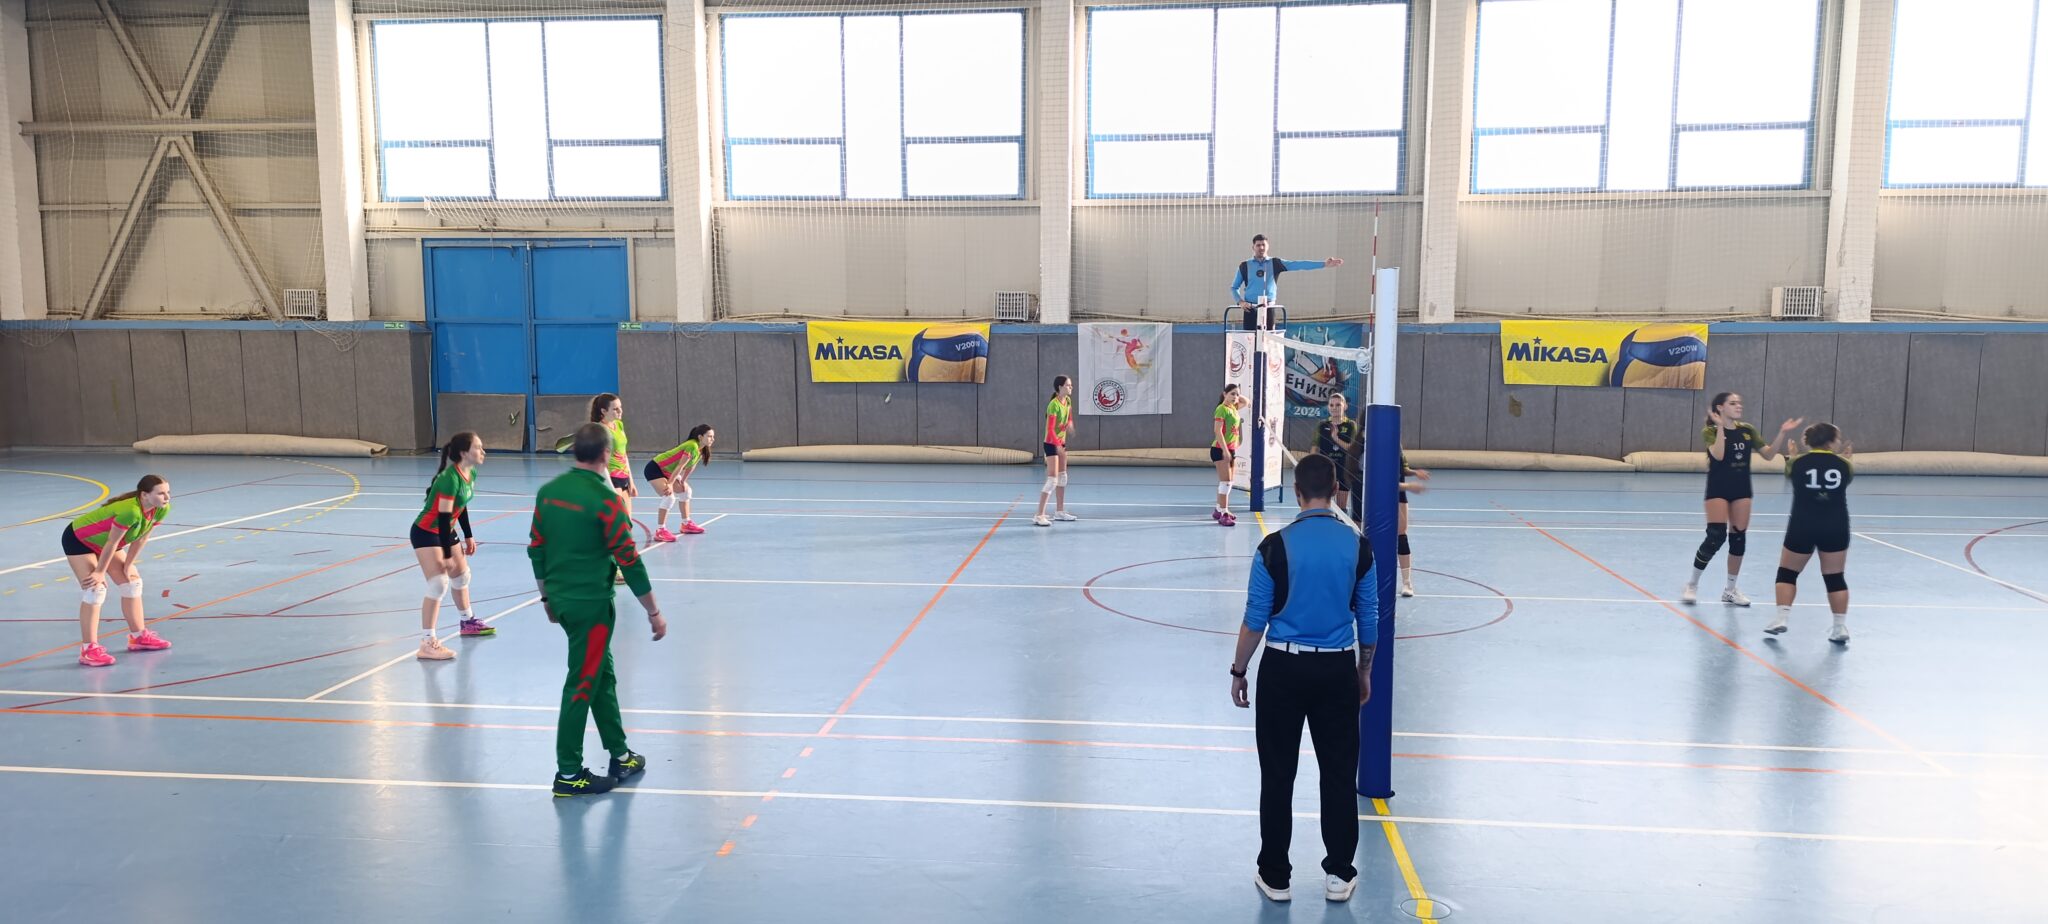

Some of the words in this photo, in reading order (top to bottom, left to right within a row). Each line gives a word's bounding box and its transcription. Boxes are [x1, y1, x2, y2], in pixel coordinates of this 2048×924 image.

[1668, 344, 1698, 356] V200W
[1294, 406, 1321, 417] 2024
[1733, 442, 1745, 451] 10
[1805, 468, 1842, 490] 19
